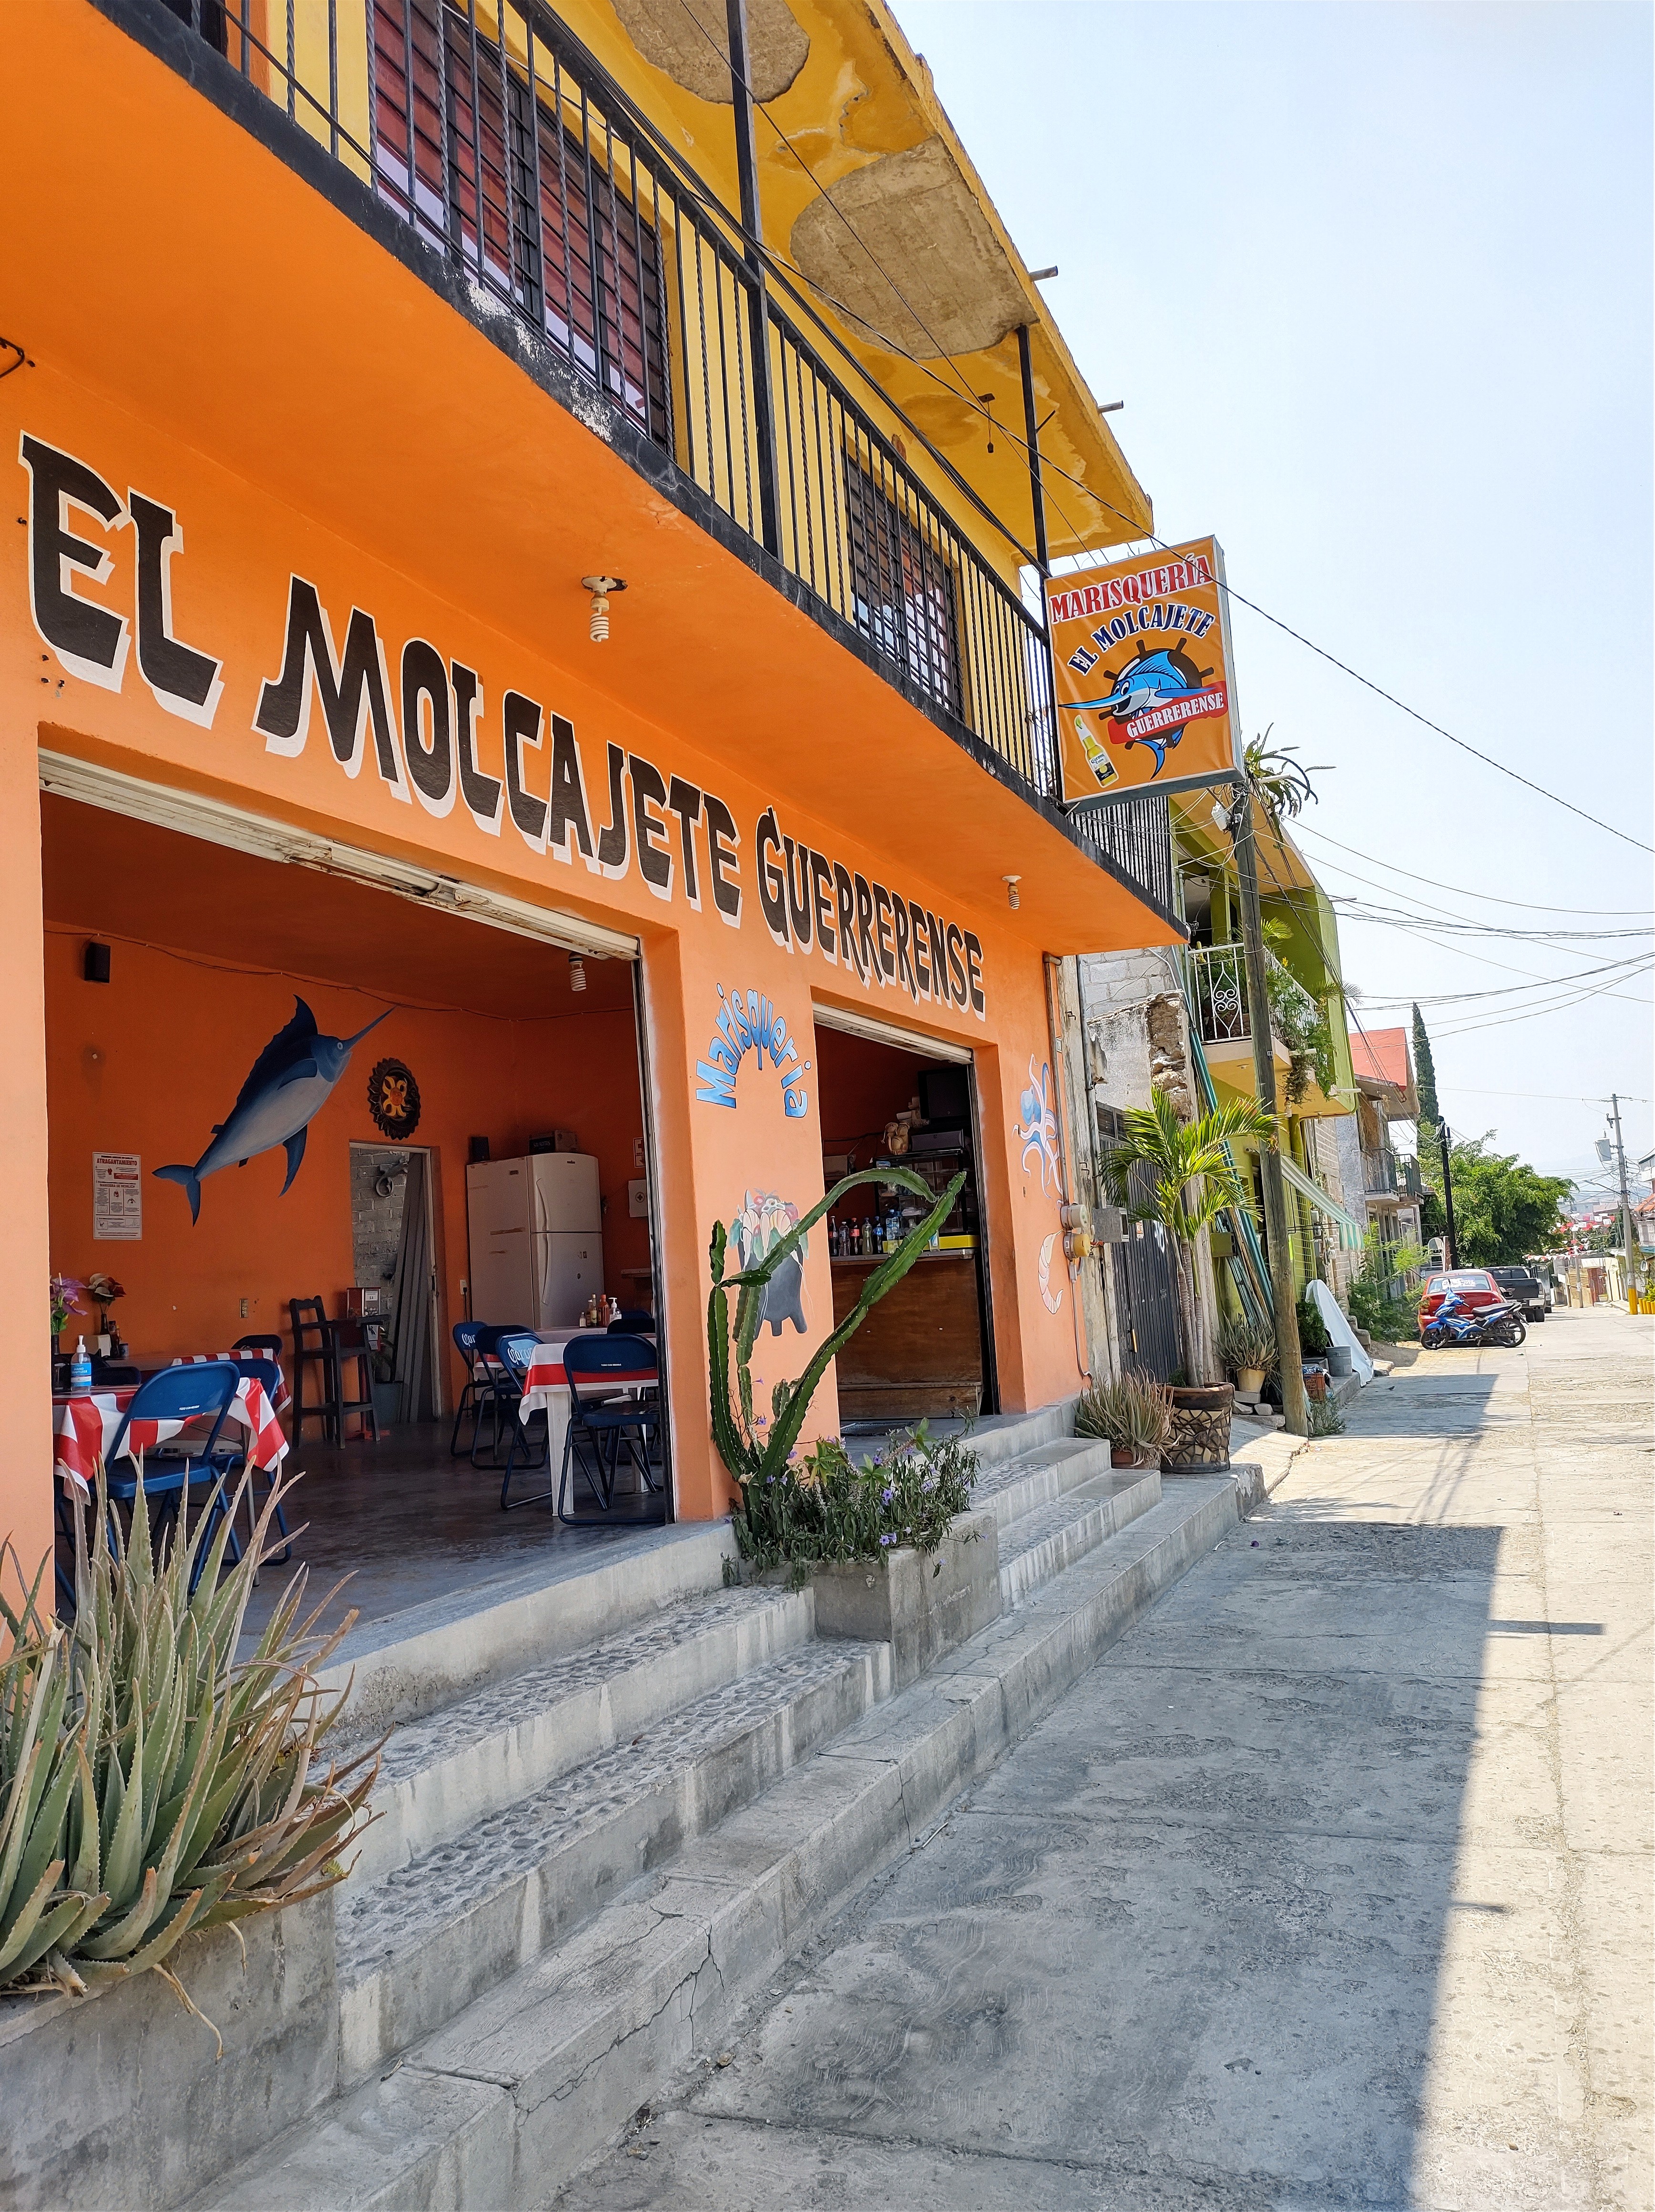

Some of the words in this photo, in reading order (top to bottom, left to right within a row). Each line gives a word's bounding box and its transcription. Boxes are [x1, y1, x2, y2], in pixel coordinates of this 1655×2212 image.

[1050, 554, 1212, 623] MARISQUERÍA
[1068, 646, 1098, 676] EL
[1092, 604, 1216, 652] MOLCAJETE
[18, 430, 224, 729] EL
[251, 572, 742, 929] MOLCAJETE
[756, 805, 986, 1022] GUERRERENSE
[1126, 692, 1224, 738] GUERRERENSE
[1091, 754, 1104, 763] Corona
[695, 983, 811, 1118] Marisqueria
